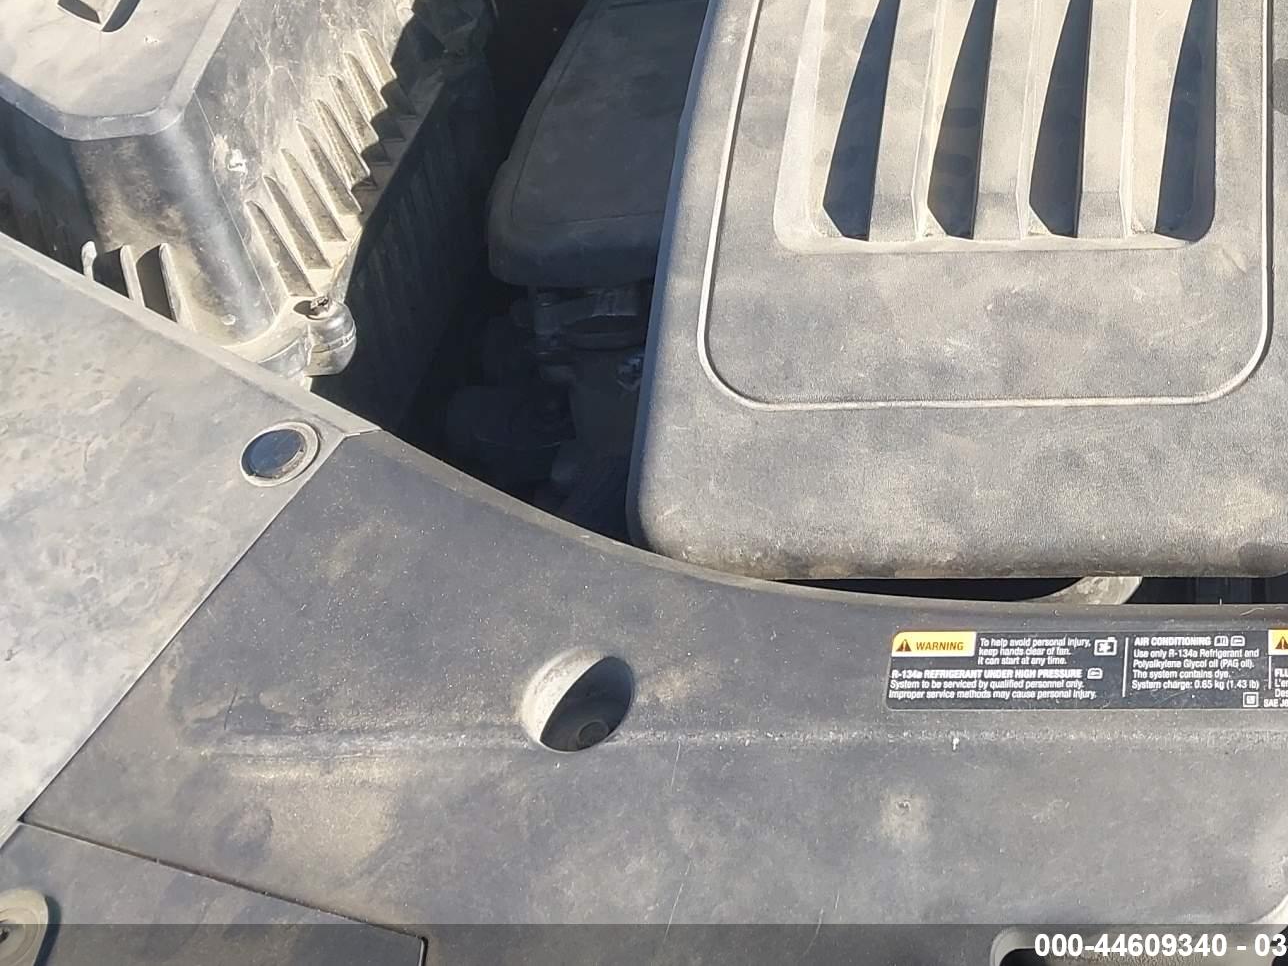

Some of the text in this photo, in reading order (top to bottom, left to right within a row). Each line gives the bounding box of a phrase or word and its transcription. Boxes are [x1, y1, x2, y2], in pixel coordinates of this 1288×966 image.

[916, 641, 964, 651] WARNING
[980, 638, 989, 647] To
[991, 638, 1008, 648] help
[1009, 638, 1031, 647] avoid
[1033, 638, 1066, 648] personal
[1134, 637, 1211, 646] AIR CONDITIONING
[979, 647, 1071, 657] keep hands clear of fan.
[1133, 649, 1260, 659] Use only R-134a Refrigerant and
[985, 657, 999, 665] can
[1001, 657, 1019, 665] start
[1021, 657, 1030, 665] at
[1030, 657, 1046, 666] any
[1047, 657, 1067, 665] time.
[1133, 659, 1254, 669] Polyalkylene Glycol oil (PAG oil).
[891, 669, 1082, 679] R-134a REFRIGERANT UNDER HIGH PRESSURE
[1133, 669, 1231, 679] The system contains dye.
[890, 680, 1084, 689] System to be serviced by qualified personnel only.
[1132, 680, 1260, 690] System charge: 0.65 kg (1.43 lb)
[888, 690, 1096, 700] Improper service methods may cause personal injury.
[1263, 698, 1278, 708] SAE
